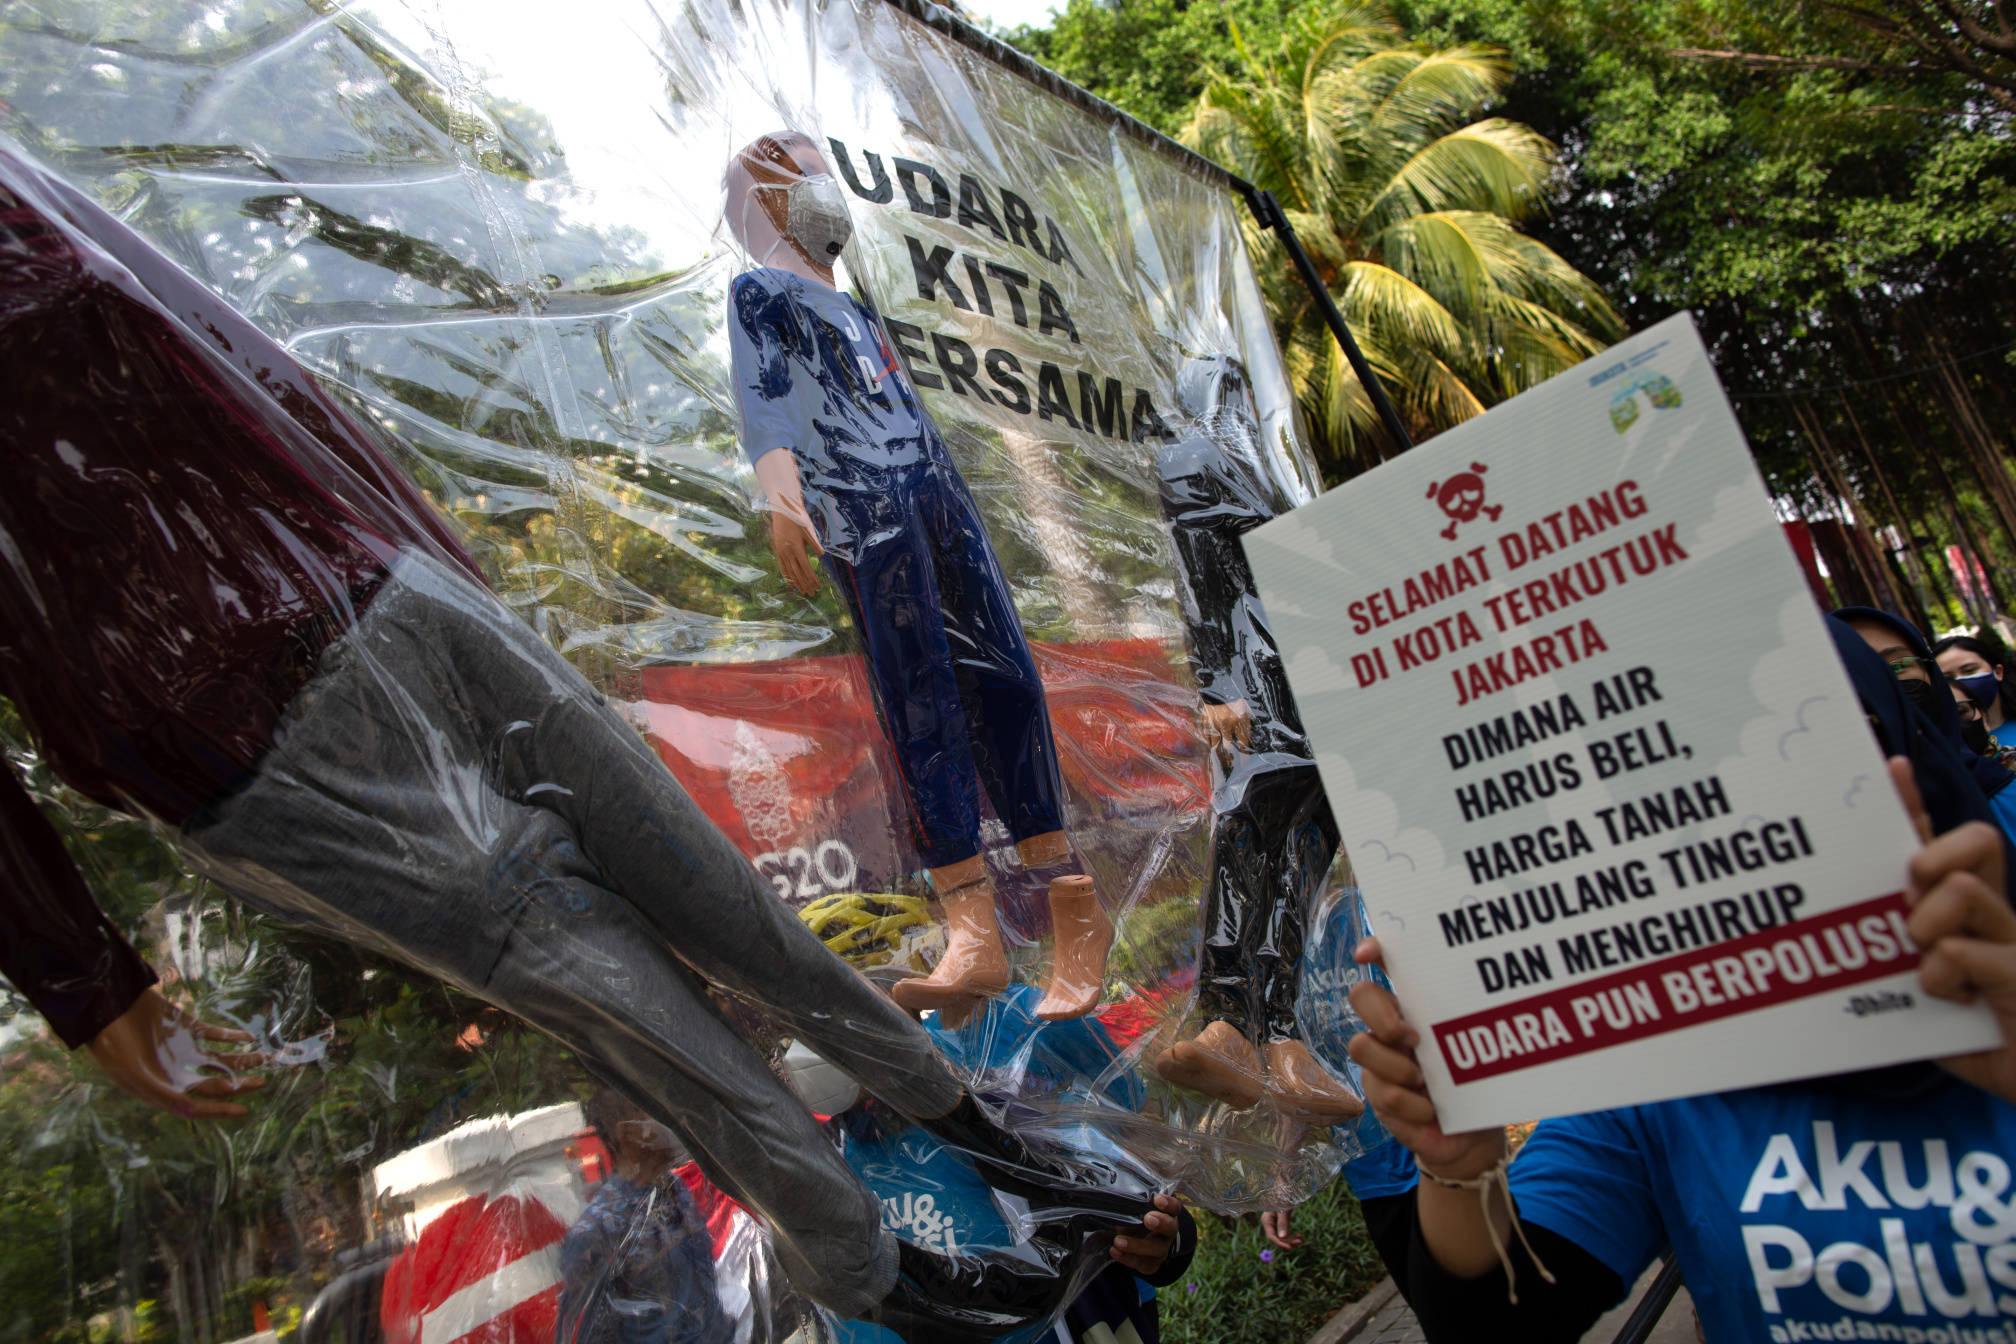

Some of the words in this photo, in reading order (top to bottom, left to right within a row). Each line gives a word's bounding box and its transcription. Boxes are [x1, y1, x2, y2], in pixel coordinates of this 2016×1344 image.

[826, 136, 1085, 279] UDARA
[904, 234, 1081, 345] KITA
[882, 316, 1181, 444] ERSAMA
[1347, 546, 1491, 635] SELAMAT
[1498, 480, 1649, 571] DATANG
[1350, 648, 1389, 688] DI
[1392, 611, 1483, 671] KOTA
[1483, 523, 1690, 633] TERKUTUK
[1442, 693, 1586, 770] DIMANA
[1592, 666, 1663, 719] AIR
[1452, 618, 1608, 706] JAKARTA
[1454, 752, 1582, 822] HARUS
[1587, 720, 1693, 780] BELI,
[1463, 819, 1594, 885] HARGA
[1595, 776, 1732, 846] TANAH
[1438, 860, 1657, 948] MENJULANG
[1659, 816, 1816, 889] TINGGI
[1476, 944, 1553, 994] DAN
[1557, 883, 1806, 975] MENGHIRUP
[1445, 1007, 1573, 1070] UDARA
[1570, 980, 1662, 1037] PUN
[1661, 909, 1919, 1014] BERPOLUSI
[1739, 1120, 2016, 1246] Aku&
